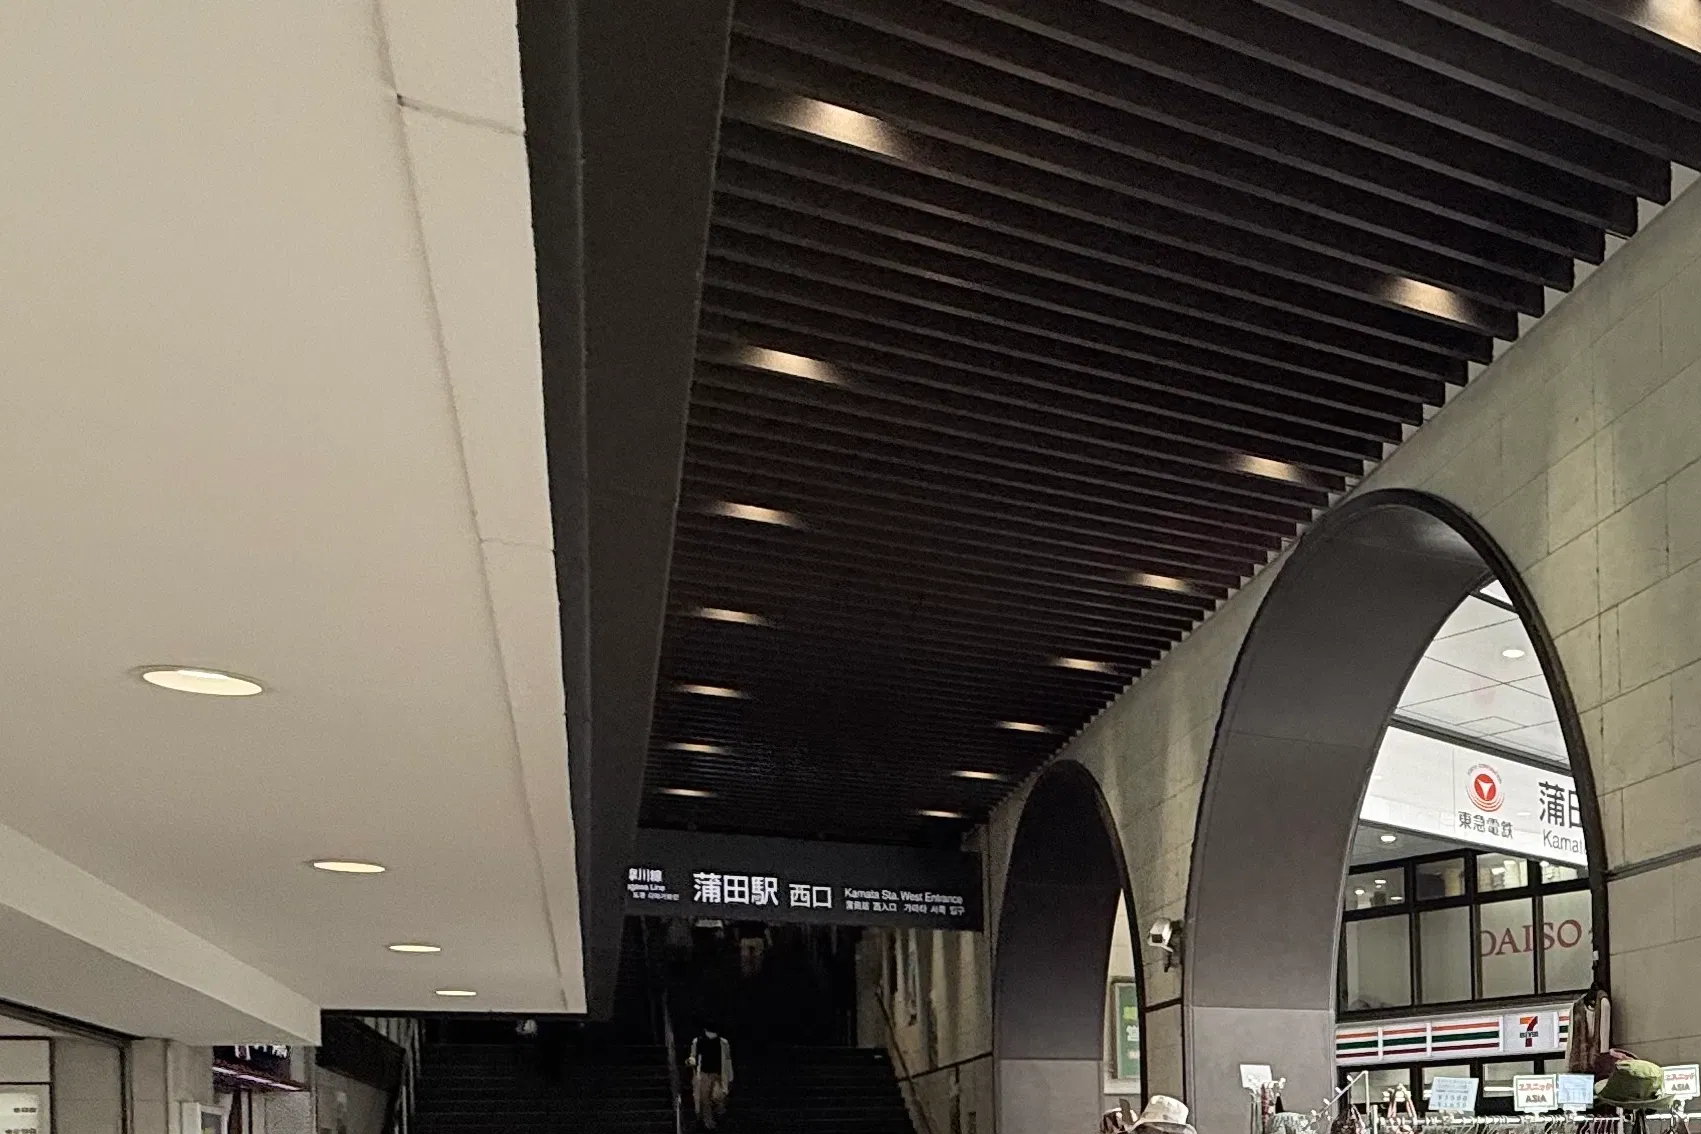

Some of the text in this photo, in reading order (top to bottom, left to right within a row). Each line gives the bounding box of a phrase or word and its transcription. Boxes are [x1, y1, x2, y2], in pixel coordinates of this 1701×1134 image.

[1458, 811, 1513, 839] 東急電鉄
[692, 872, 832, 909] 蒲田駅 西口
[844, 887, 963, 904] Kamata Sta. West Entrance
[1481, 919, 1582, 957] DAISO
[1520, 1016, 1538, 1047] 7
[1525, 1094, 1548, 1103] ASIA
